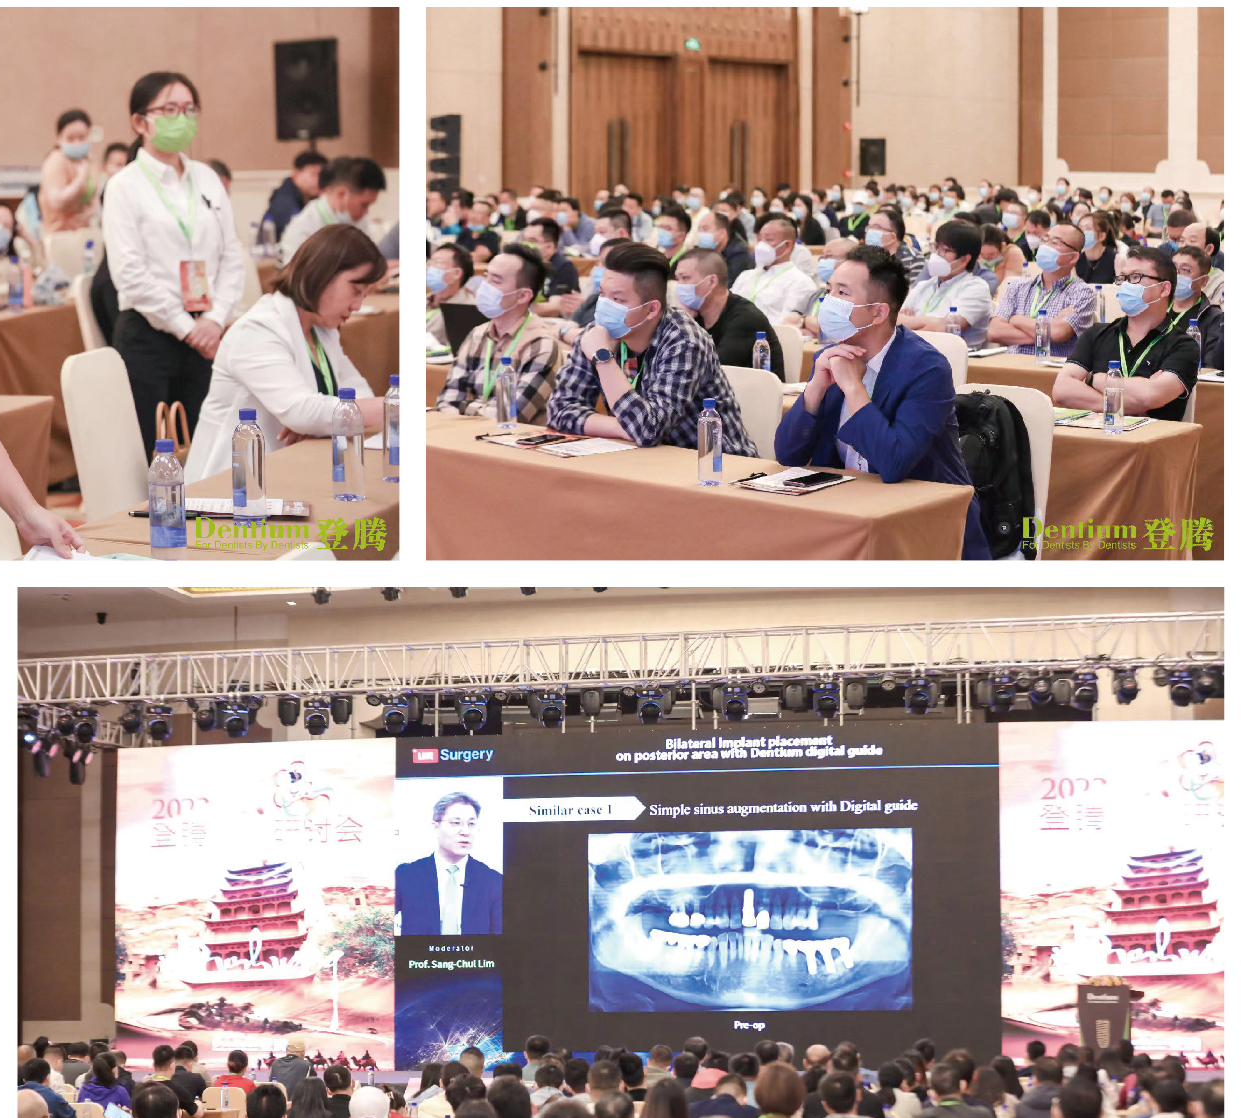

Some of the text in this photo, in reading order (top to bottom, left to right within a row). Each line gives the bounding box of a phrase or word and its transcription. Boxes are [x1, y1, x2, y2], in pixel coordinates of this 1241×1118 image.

[665, 735, 833, 750] Bilateral Implant placement
[440, 749, 494, 762] Surgery
[615, 744, 883, 763] on posterior area with Dentium digital guide
[529, 804, 613, 816] Similar case 1
[649, 799, 919, 819] Simple sinus augmentation with Digital guide
[408, 959, 495, 971] Prof. Sang-Chul Lim
[733, 1020, 766, 1032] Pre-op
